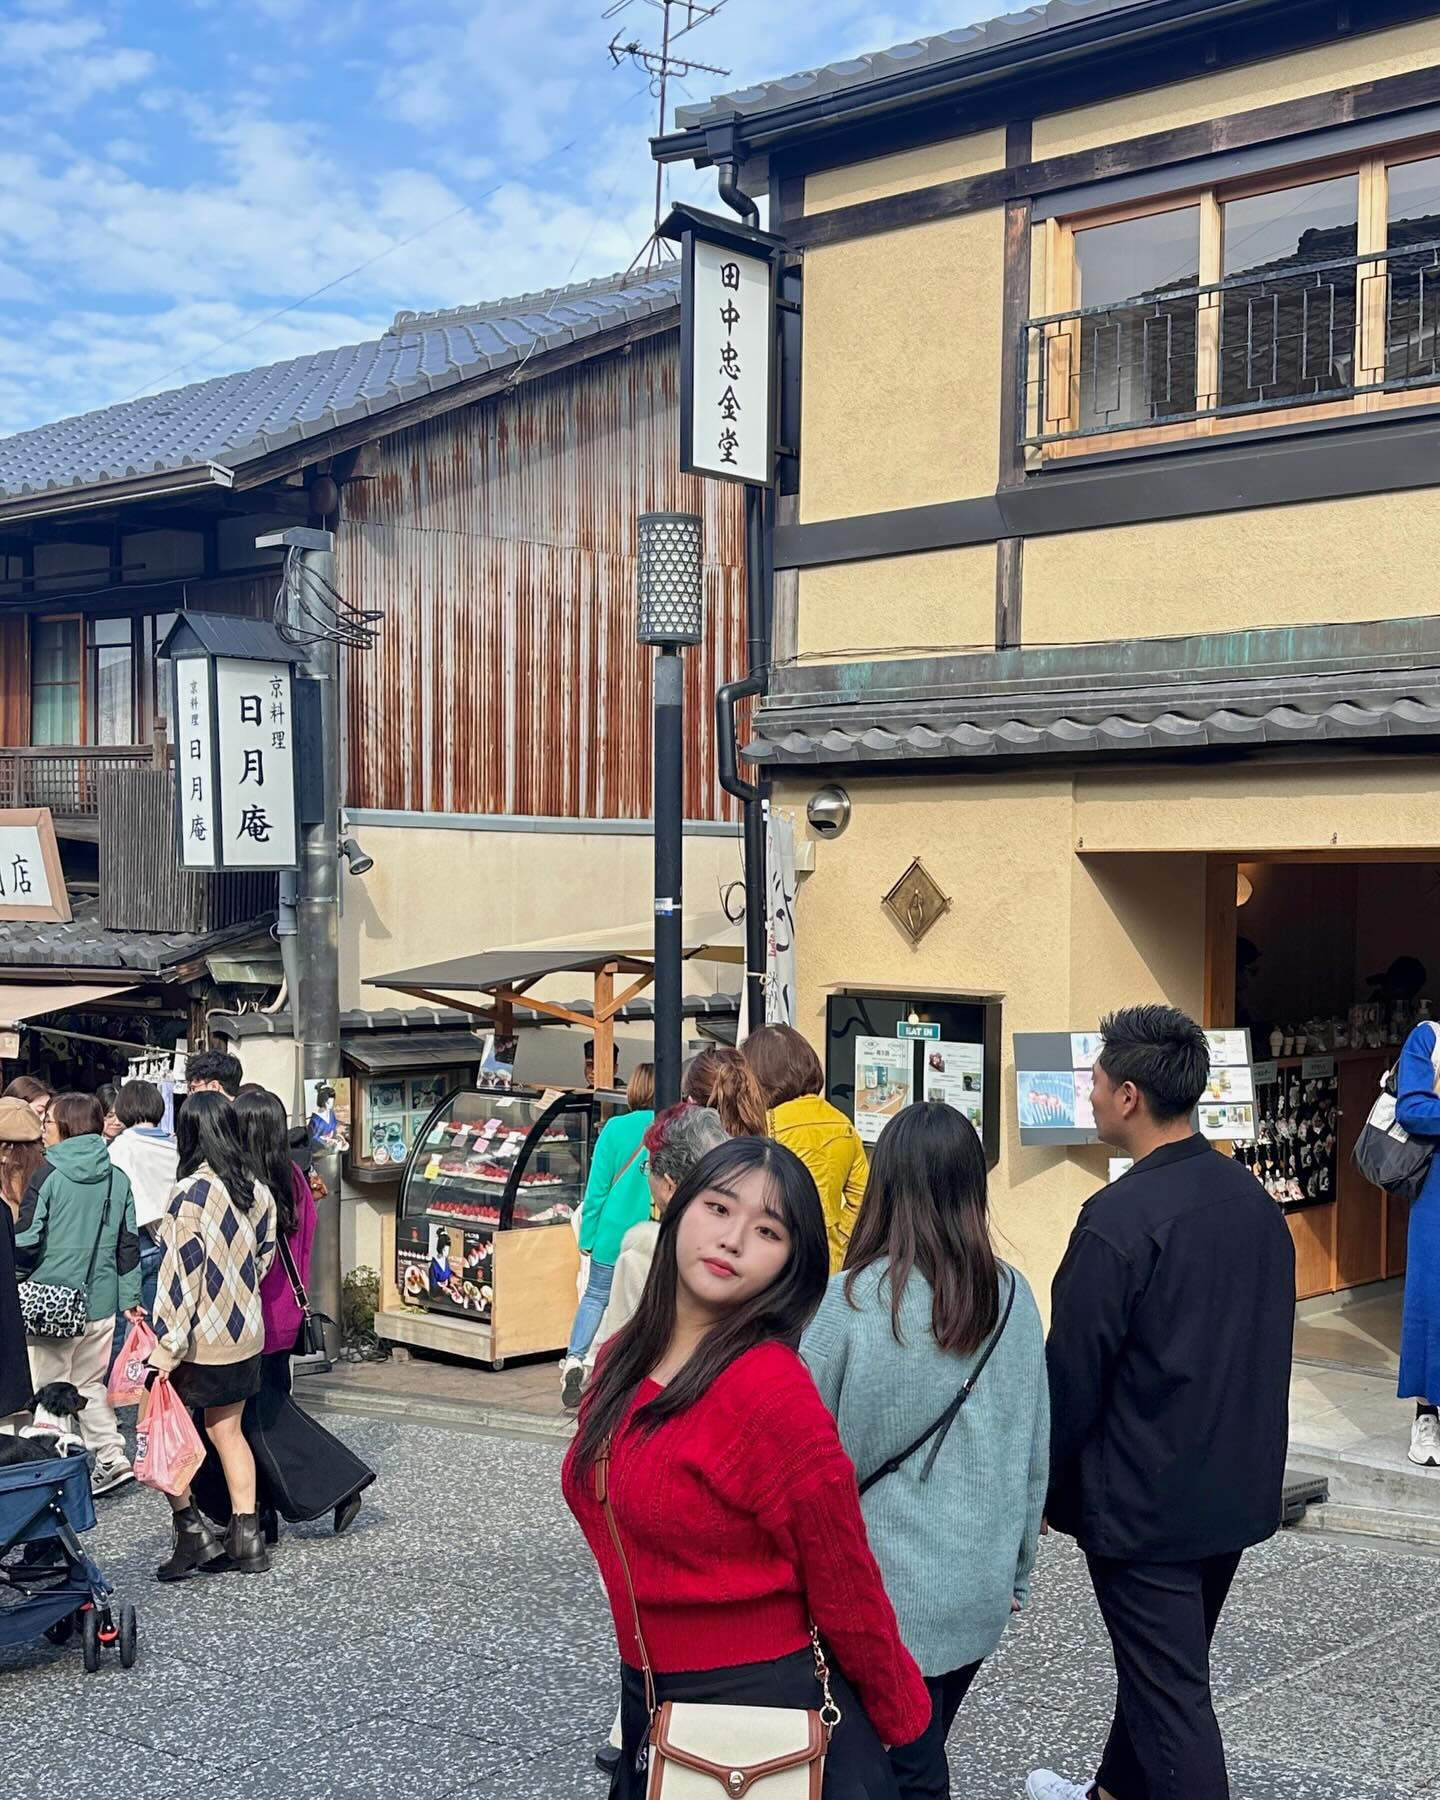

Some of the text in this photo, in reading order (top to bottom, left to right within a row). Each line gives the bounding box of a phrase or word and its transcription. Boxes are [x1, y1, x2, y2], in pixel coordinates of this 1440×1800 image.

[718, 262, 741, 465] 田中忠金堂
[189, 679, 207, 842] 京料理 日月庵
[268, 674, 286, 750] 京料理
[235, 694, 275, 844] 日月庵
[0, 852, 32, 897] 店
[905, 1026, 933, 1037] EAT IN
